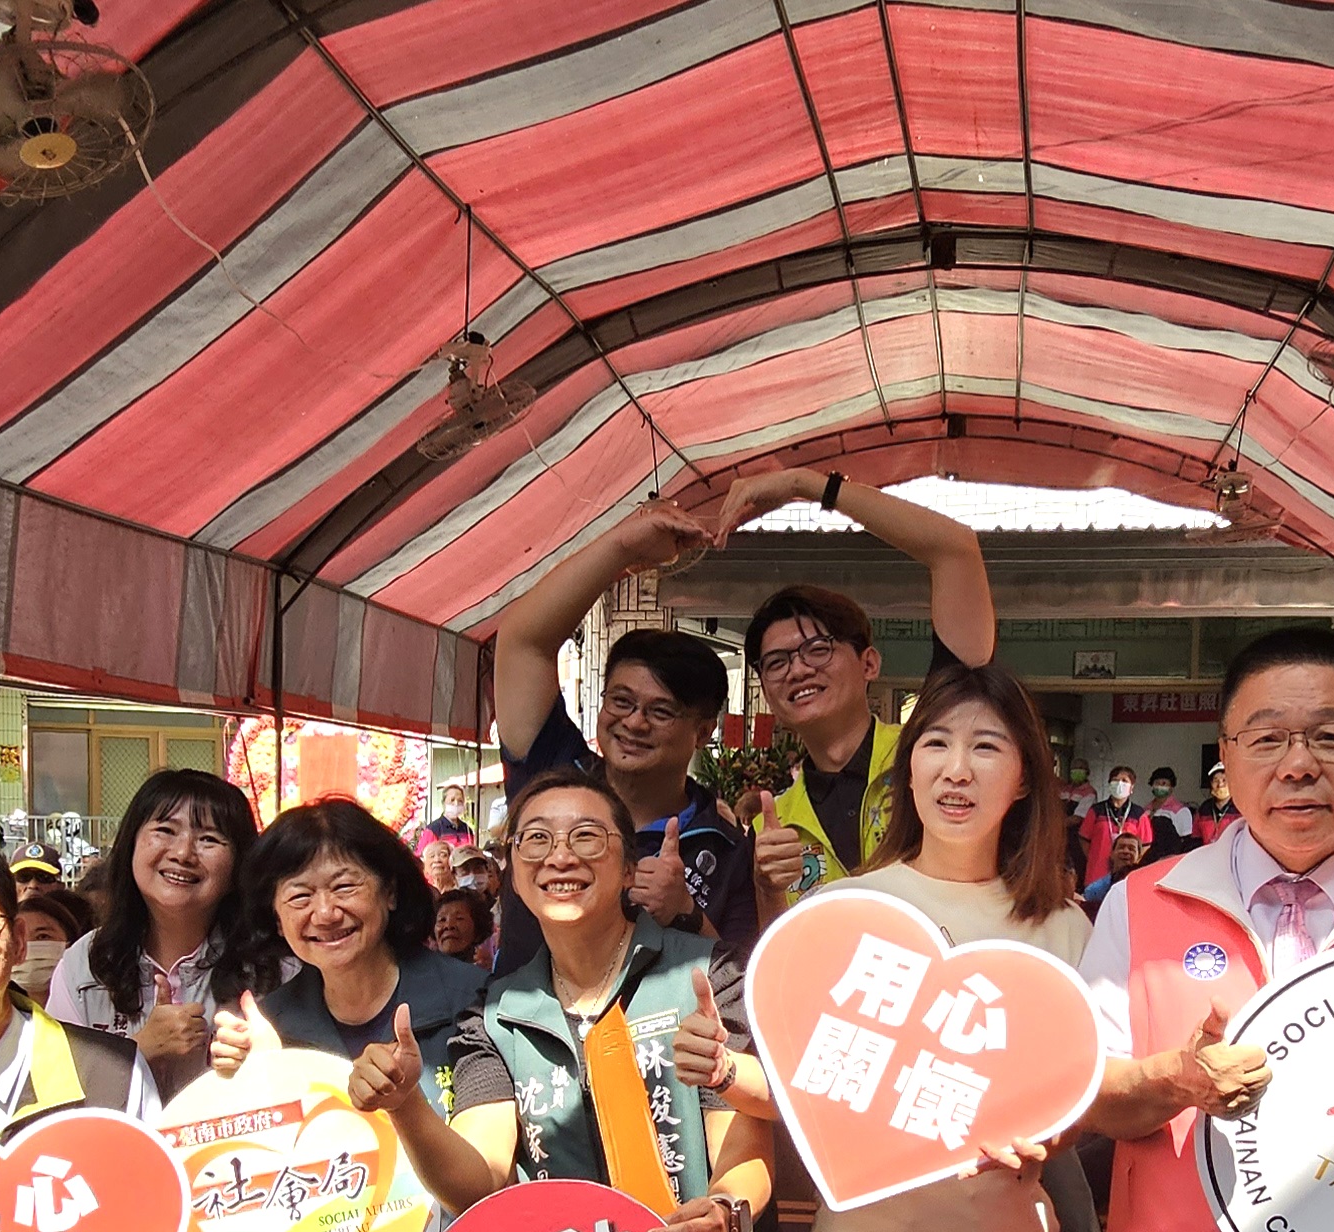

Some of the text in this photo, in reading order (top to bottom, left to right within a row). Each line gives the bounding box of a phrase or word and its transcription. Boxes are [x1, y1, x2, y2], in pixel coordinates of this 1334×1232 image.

[1122, 693, 1221, 712] 東昇社區照
[829, 934, 1008, 1053] 用心
[790, 1012, 991, 1149] 關懷
[178, 1111, 271, 1147] 臺南市政府
[193, 1151, 366, 1221] 社會局
[319, 1209, 361, 1226] SOCIAL
